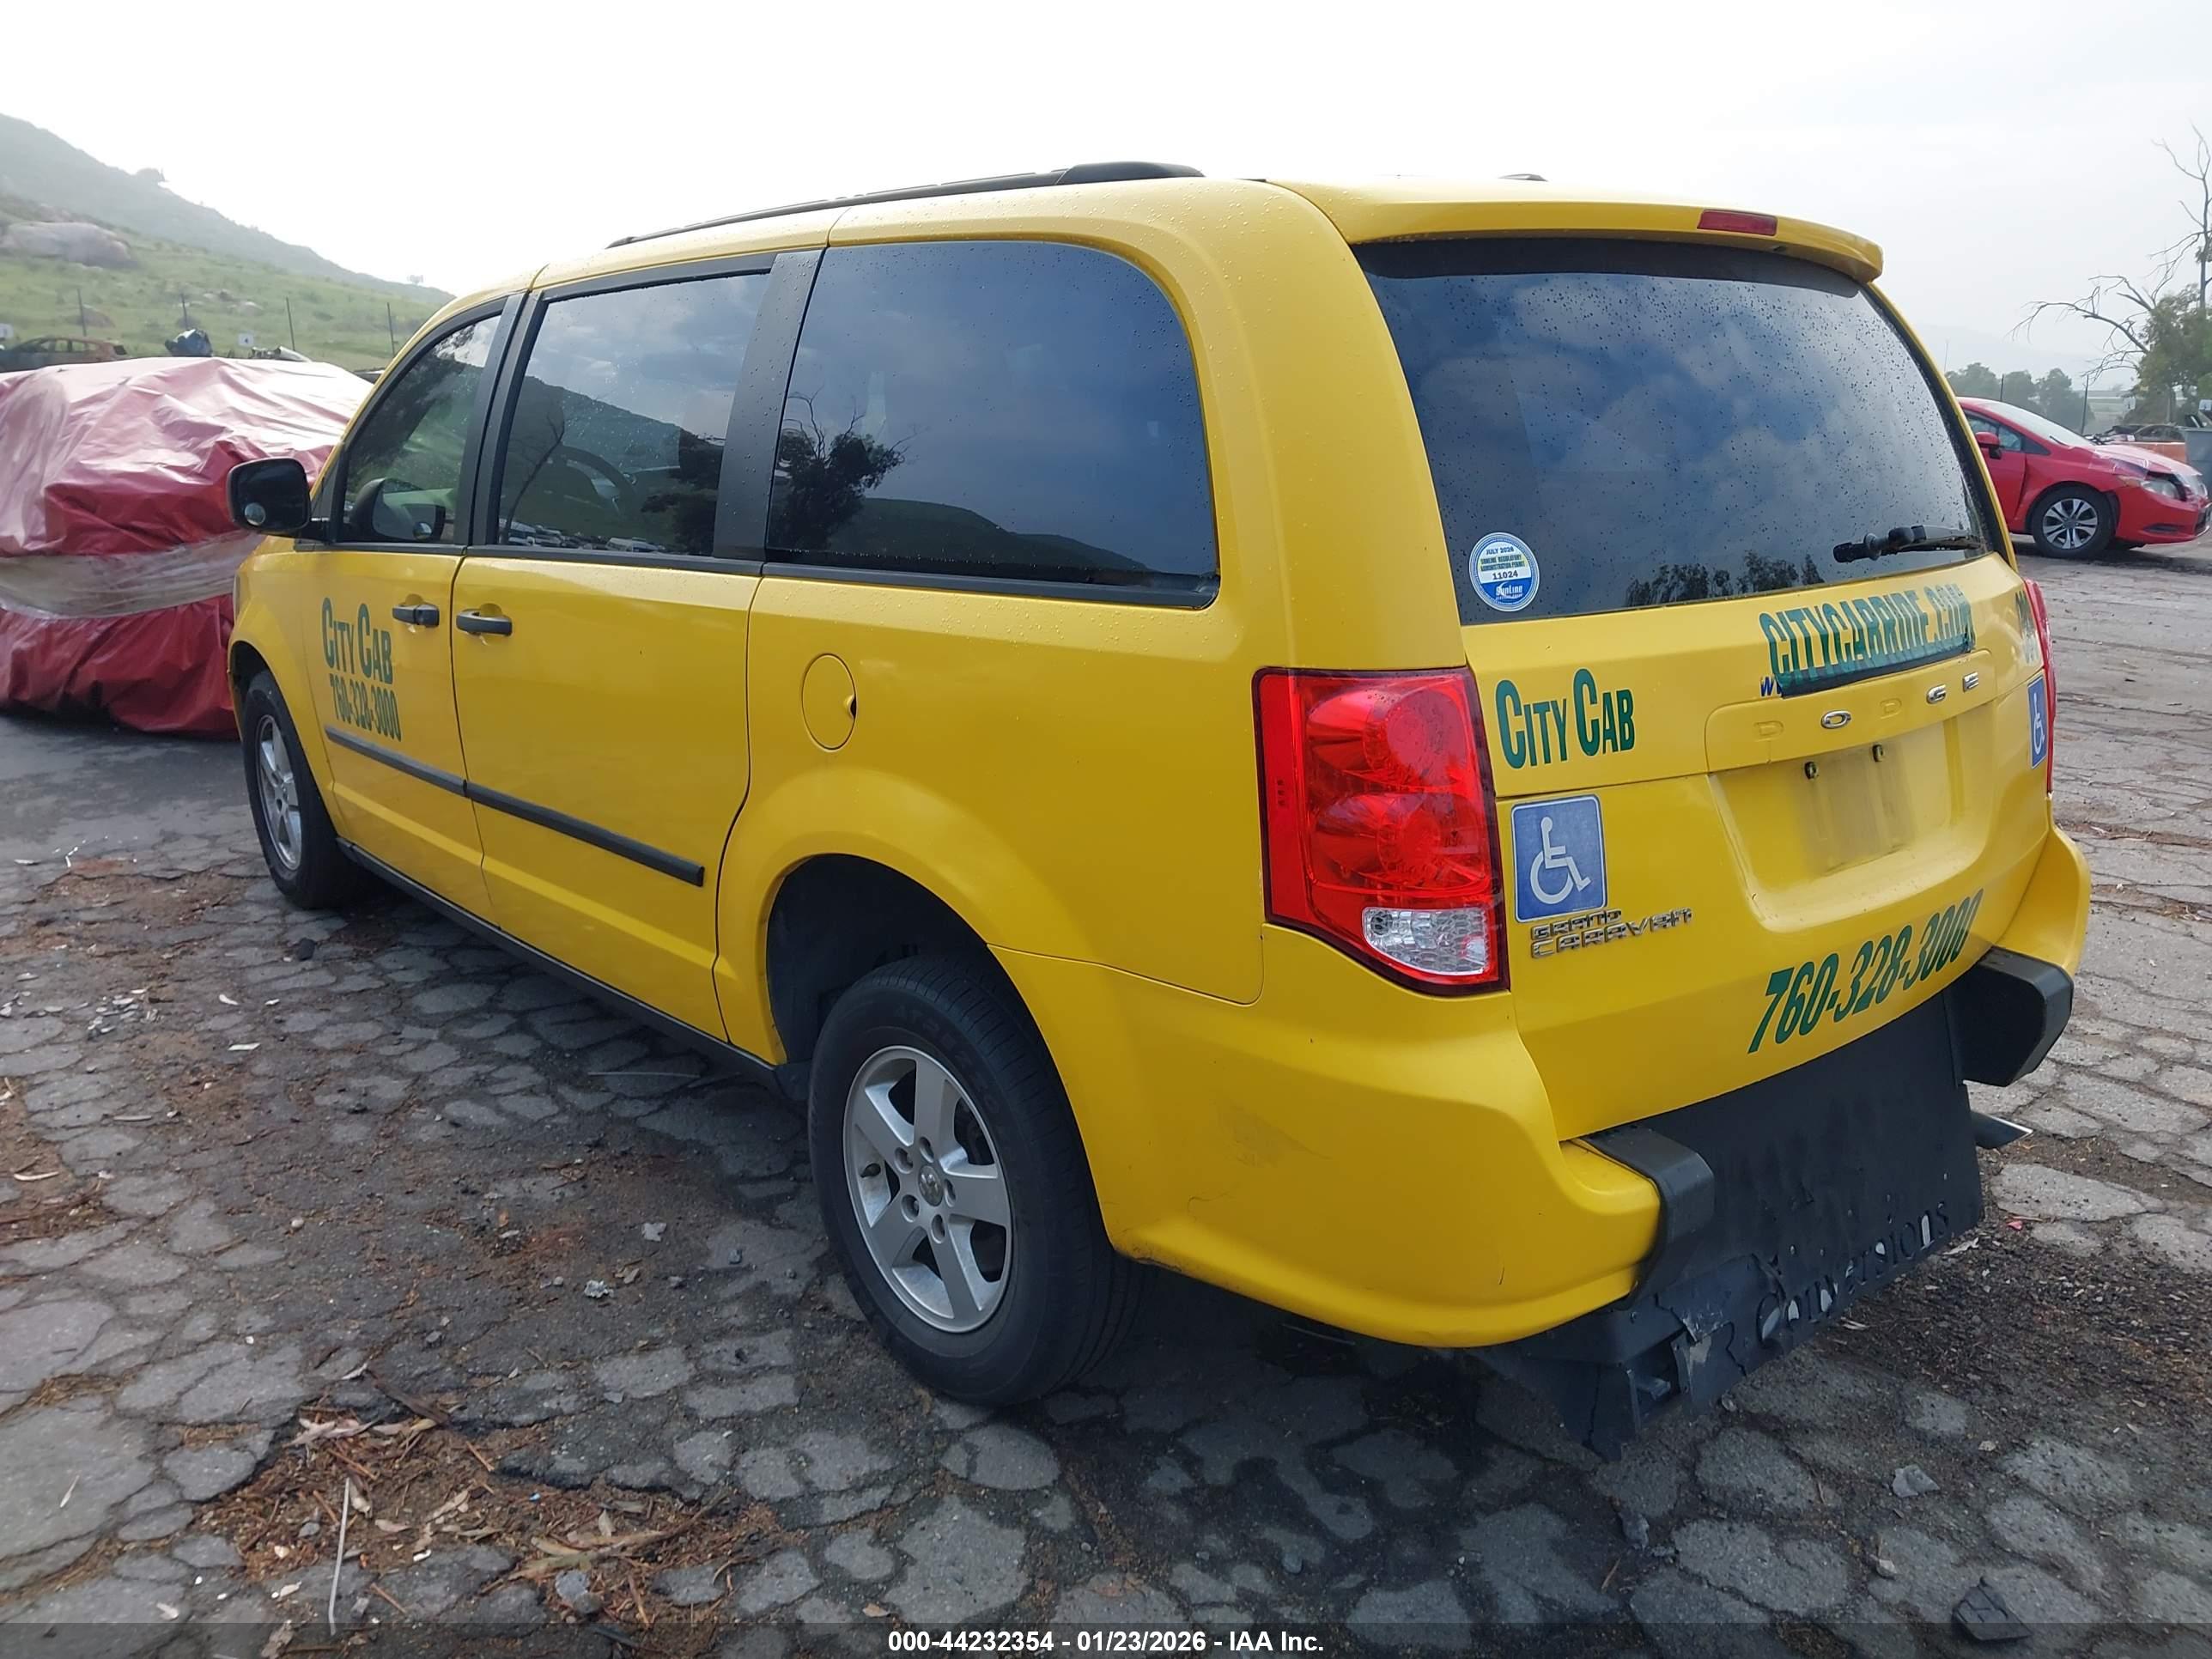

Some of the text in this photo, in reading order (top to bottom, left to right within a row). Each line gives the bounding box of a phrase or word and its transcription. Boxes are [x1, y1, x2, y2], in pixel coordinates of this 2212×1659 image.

[1486, 547, 1498, 556] JULY
[1492, 570, 1518, 580] 11024
[329, 672, 402, 742] 760-328-3000
[1531, 908, 1622, 941] GRAND
[1531, 906, 1694, 959] CARAVAN
[1747, 887, 1984, 1054] 760-328-3000
